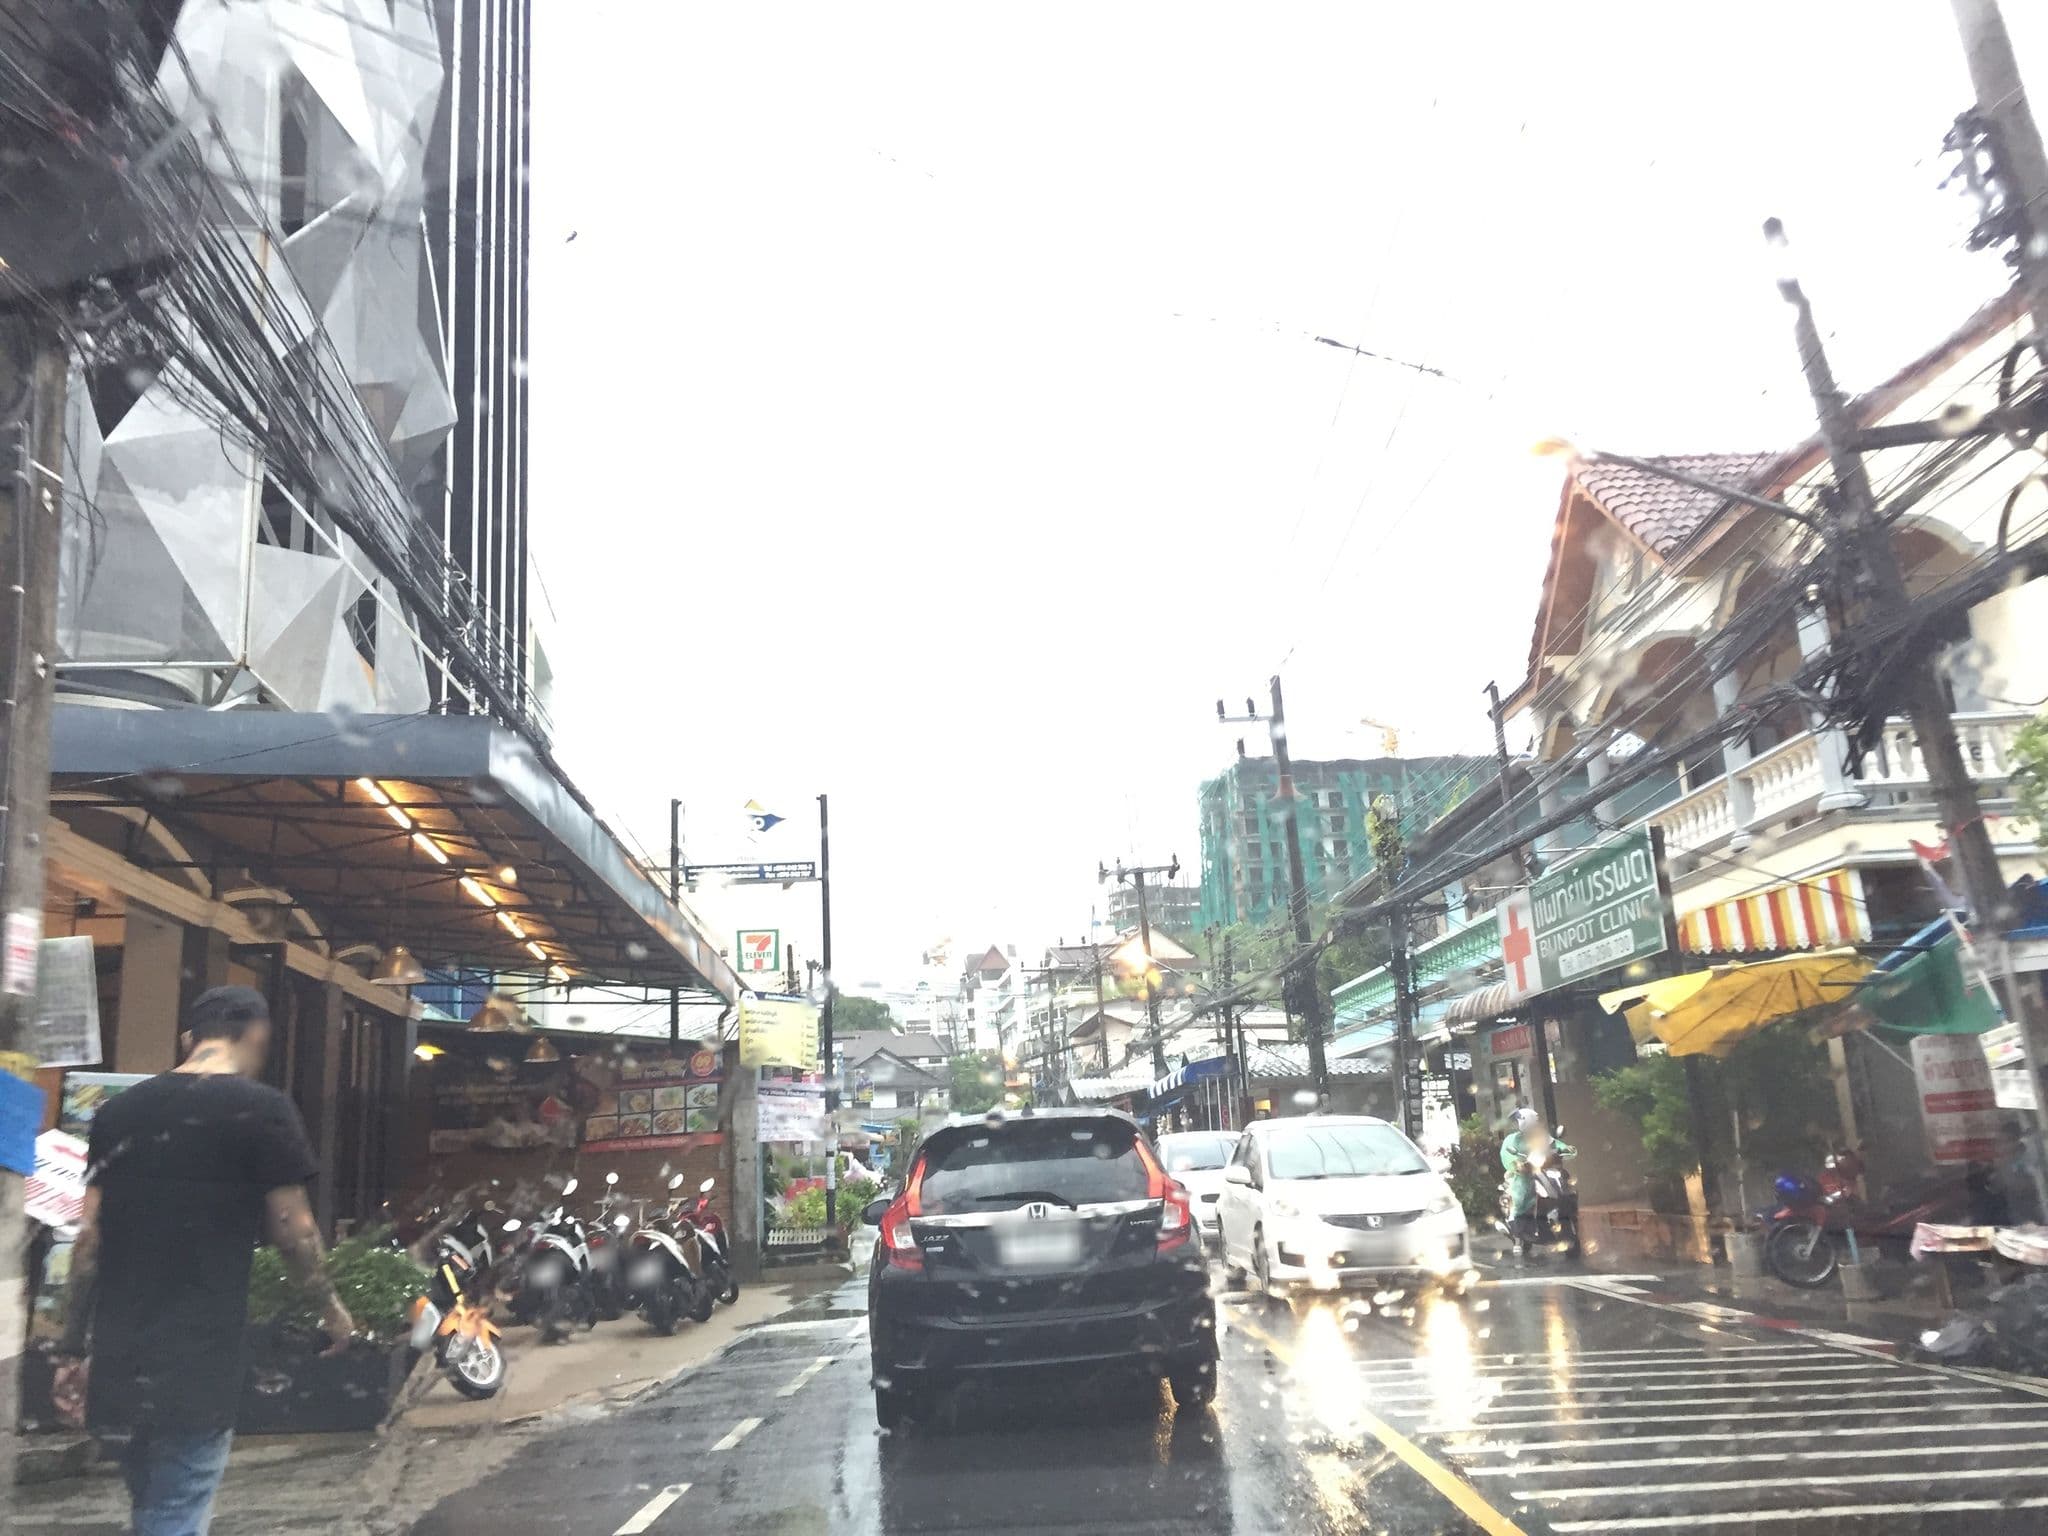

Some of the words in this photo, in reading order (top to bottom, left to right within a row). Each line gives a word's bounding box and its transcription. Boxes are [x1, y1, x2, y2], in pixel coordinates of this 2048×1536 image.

[1539, 919, 1595, 959] BUNPOT
[1599, 895, 1651, 935] CLINIC
[746, 935, 771, 969] 7
[920, 1233, 950, 1244] JAZZ
